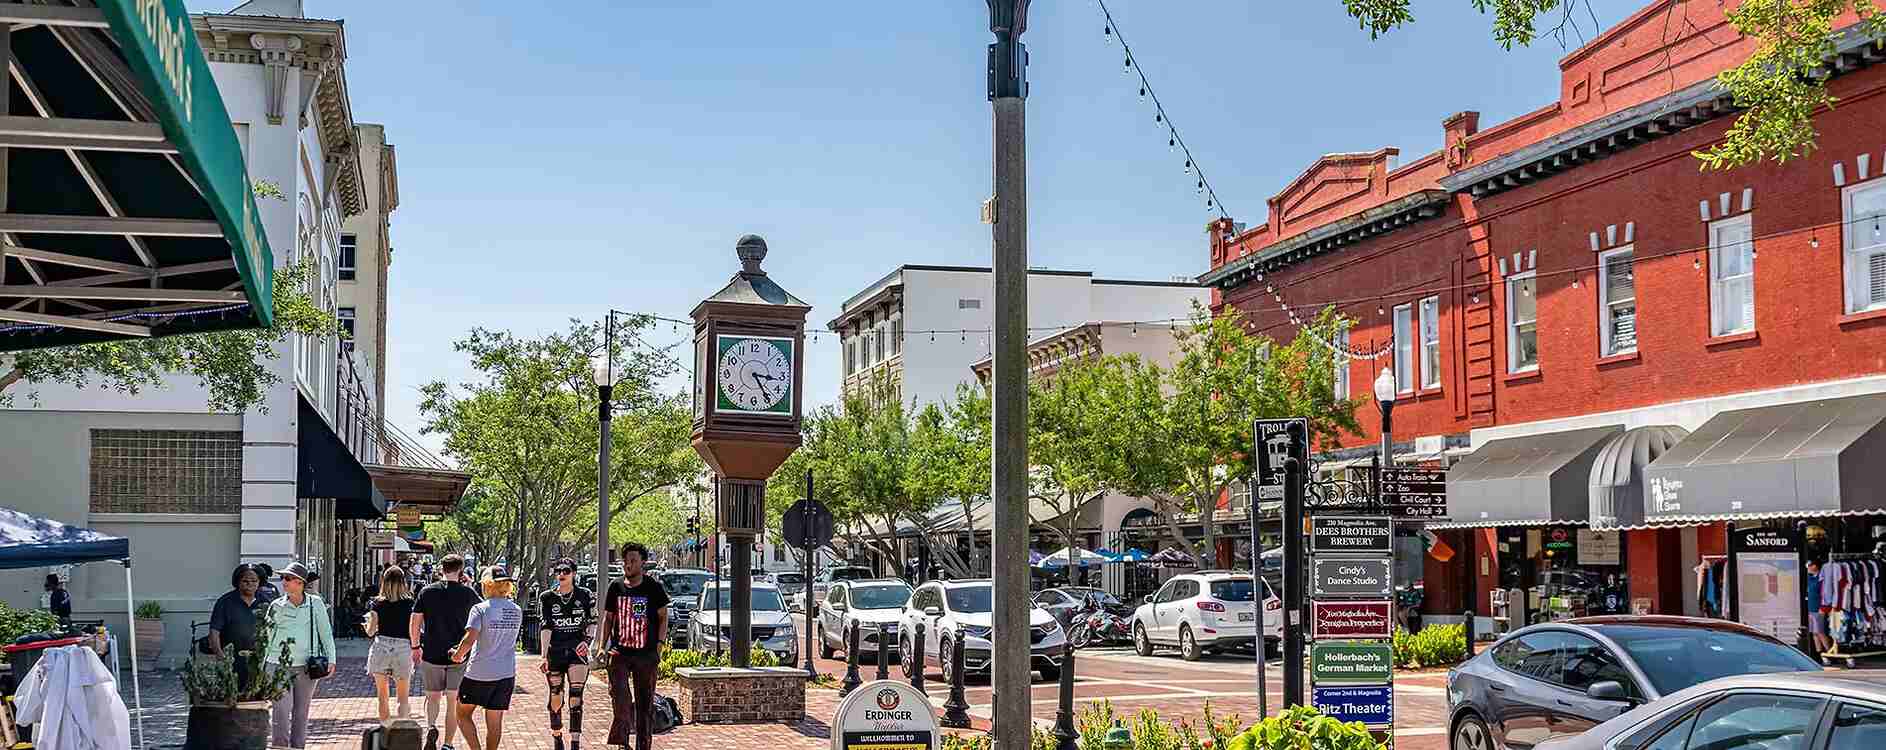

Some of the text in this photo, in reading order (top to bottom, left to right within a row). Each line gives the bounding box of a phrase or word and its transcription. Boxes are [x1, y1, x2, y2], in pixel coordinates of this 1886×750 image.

[739, 346, 744, 355] 11
[751, 344, 759, 352] 12
[728, 356, 737, 365] 10
[776, 358, 782, 367] 2
[724, 369, 730, 379] 9
[779, 371, 785, 381] 3
[728, 384, 735, 393] 8
[774, 385, 781, 393] 4
[739, 393, 744, 402] 7
[751, 396, 757, 406] 6
[763, 393, 770, 403] 5
[1273, 473, 1284, 484] ST
[1412, 473, 1428, 481] Train
[1397, 484, 1410, 492] Zoo
[1400, 495, 1431, 503] Civil Court
[1406, 506, 1433, 516] City Hall
[1338, 519, 1364, 527] Magnolia
[1316, 527, 1390, 536] DEES BROTHERS
[1331, 537, 1373, 546] BREWERY
[1746, 535, 1788, 546] SANFORD
[1338, 566, 1366, 576] Cindy's
[1327, 576, 1378, 585] Dance Studio
[1324, 653, 1380, 661] Hollerbach's
[1317, 664, 1388, 672] German Market
[1319, 703, 1386, 714] Ritz Theater
[865, 710, 912, 720] ERDINGER
